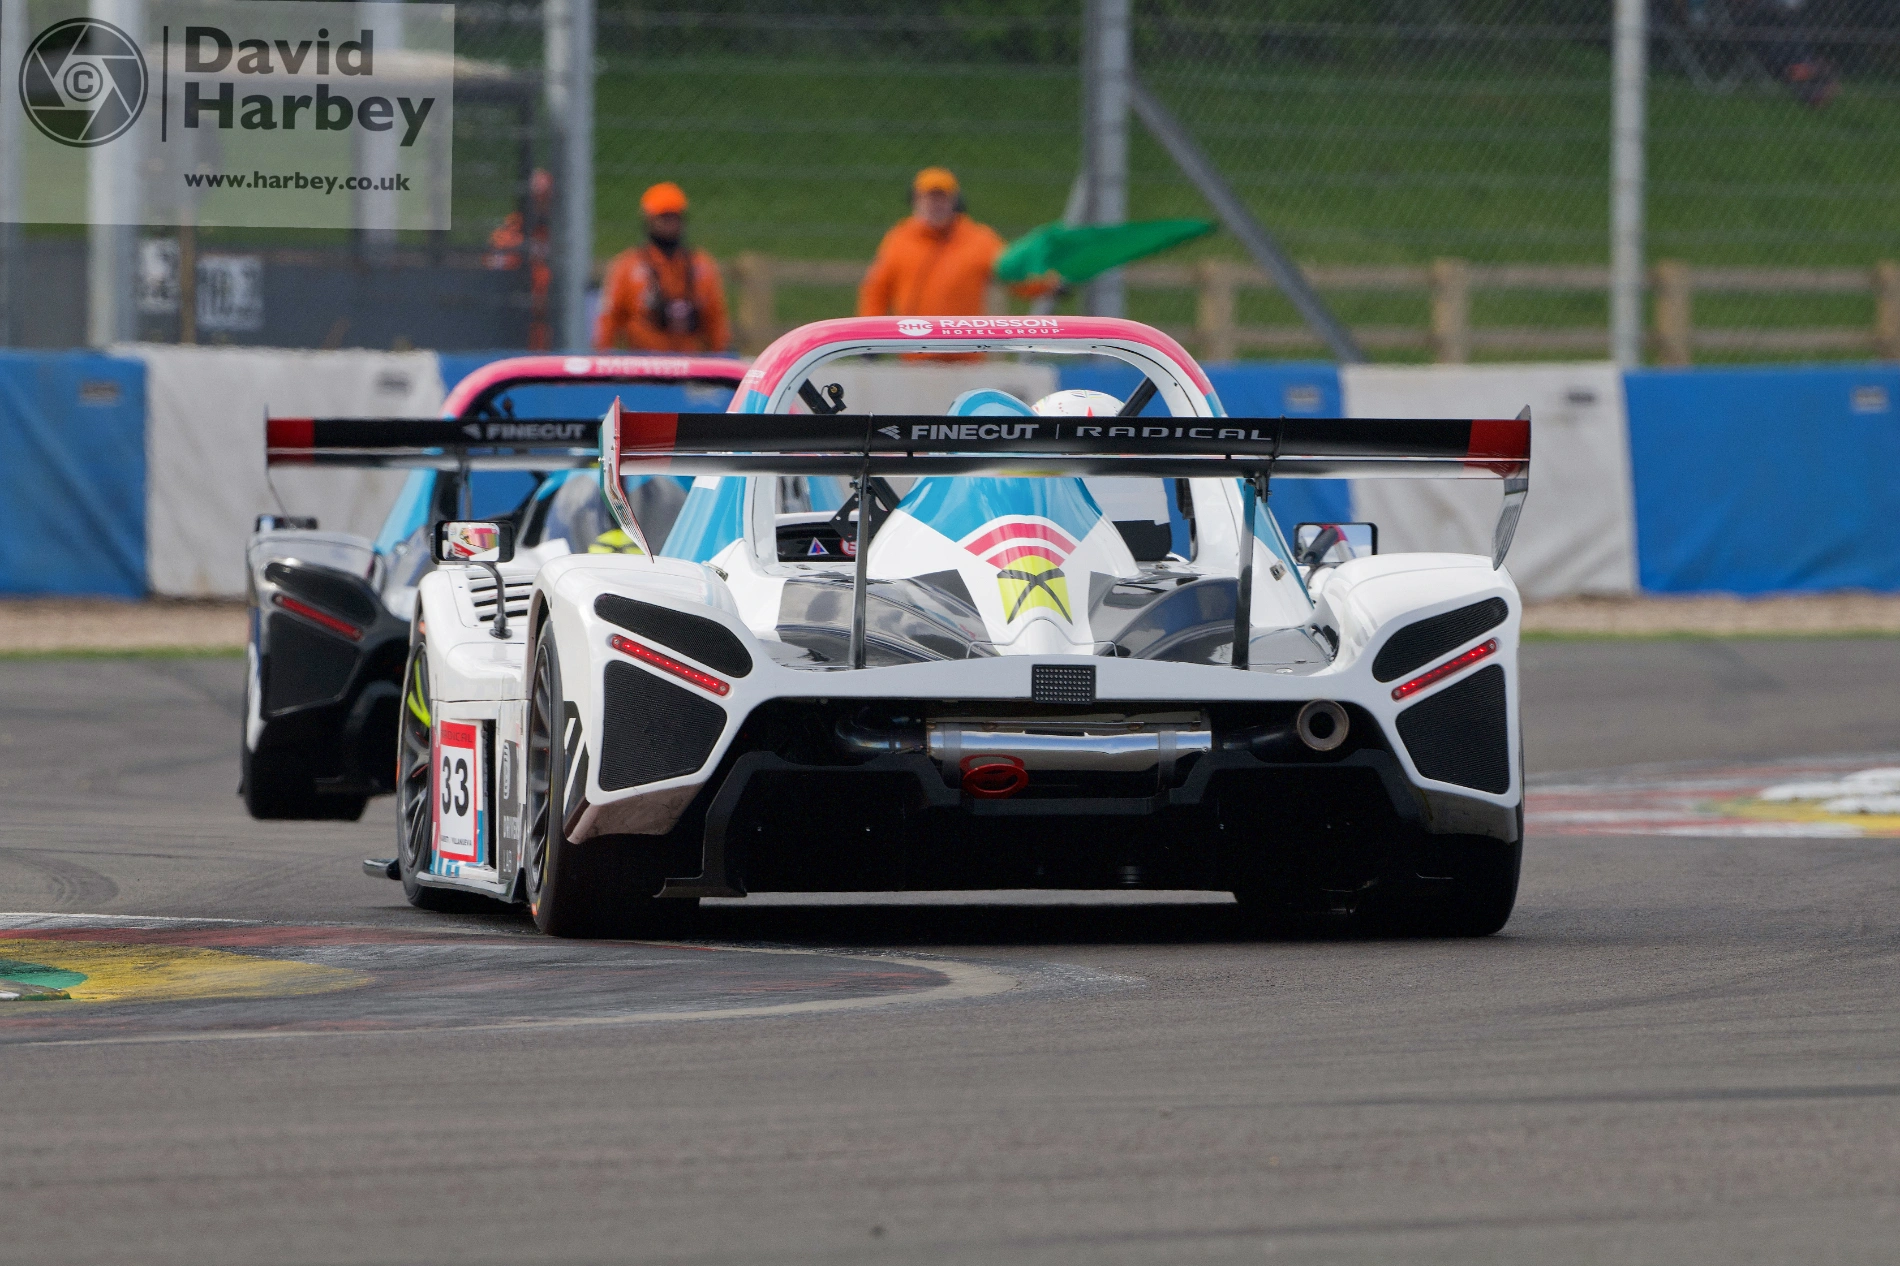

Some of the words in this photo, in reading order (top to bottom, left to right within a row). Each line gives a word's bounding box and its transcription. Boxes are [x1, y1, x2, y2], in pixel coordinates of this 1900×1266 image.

[939, 318, 1058, 328] RADISSON
[486, 423, 586, 440] FINECUT
[911, 424, 1039, 440] FINECUT
[1076, 426, 1272, 441] RADICAL
[441, 755, 470, 817] 33
